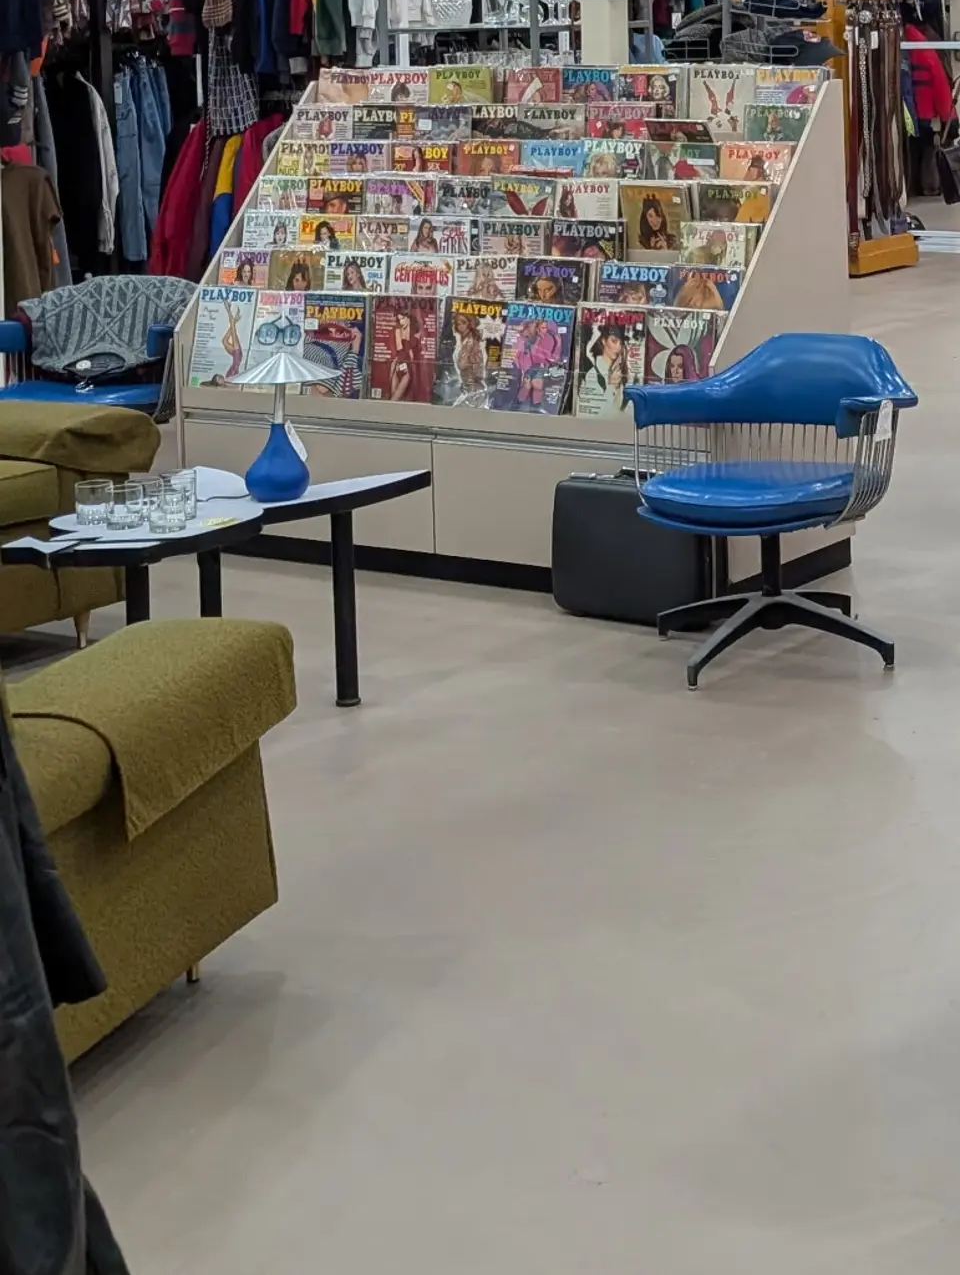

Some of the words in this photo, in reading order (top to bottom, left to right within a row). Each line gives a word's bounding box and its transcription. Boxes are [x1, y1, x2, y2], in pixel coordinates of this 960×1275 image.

[370, 71, 428, 85] PLAYBOY
[436, 69, 482, 80] PLAYBOY
[296, 110, 350, 122] PLAYBOY
[354, 109, 397, 123] PLAYB
[524, 109, 577, 121] PLAYBOY
[330, 142, 385, 155] PLAYBOY
[464, 145, 508, 155] PLAYBOY
[531, 146, 579, 157] PLAYBOY
[584, 140, 643, 155] PLAYBOY
[728, 149, 781, 160] PLAYBOY
[310, 179, 363, 193] PLAYBOY
[494, 181, 541, 195] PLAYBOY
[562, 184, 611, 194] PLAYBOY
[246, 213, 299, 226] PLAYBOY
[483, 223, 541, 237] PLAYBOY
[554, 224, 611, 238] PLAYBOY
[327, 254, 385, 269] PLAYBOY
[524, 264, 577, 279] PLAYBOY
[603, 265, 669, 284] PLAYBOY
[202, 287, 255, 303] PLAYBOY
[306, 305, 365, 322] PLAYBOY
[452, 301, 502, 317] PLAYBOY
[508, 304, 574, 324] PLAYBOY
[654, 318, 706, 331] PLAYBOY
